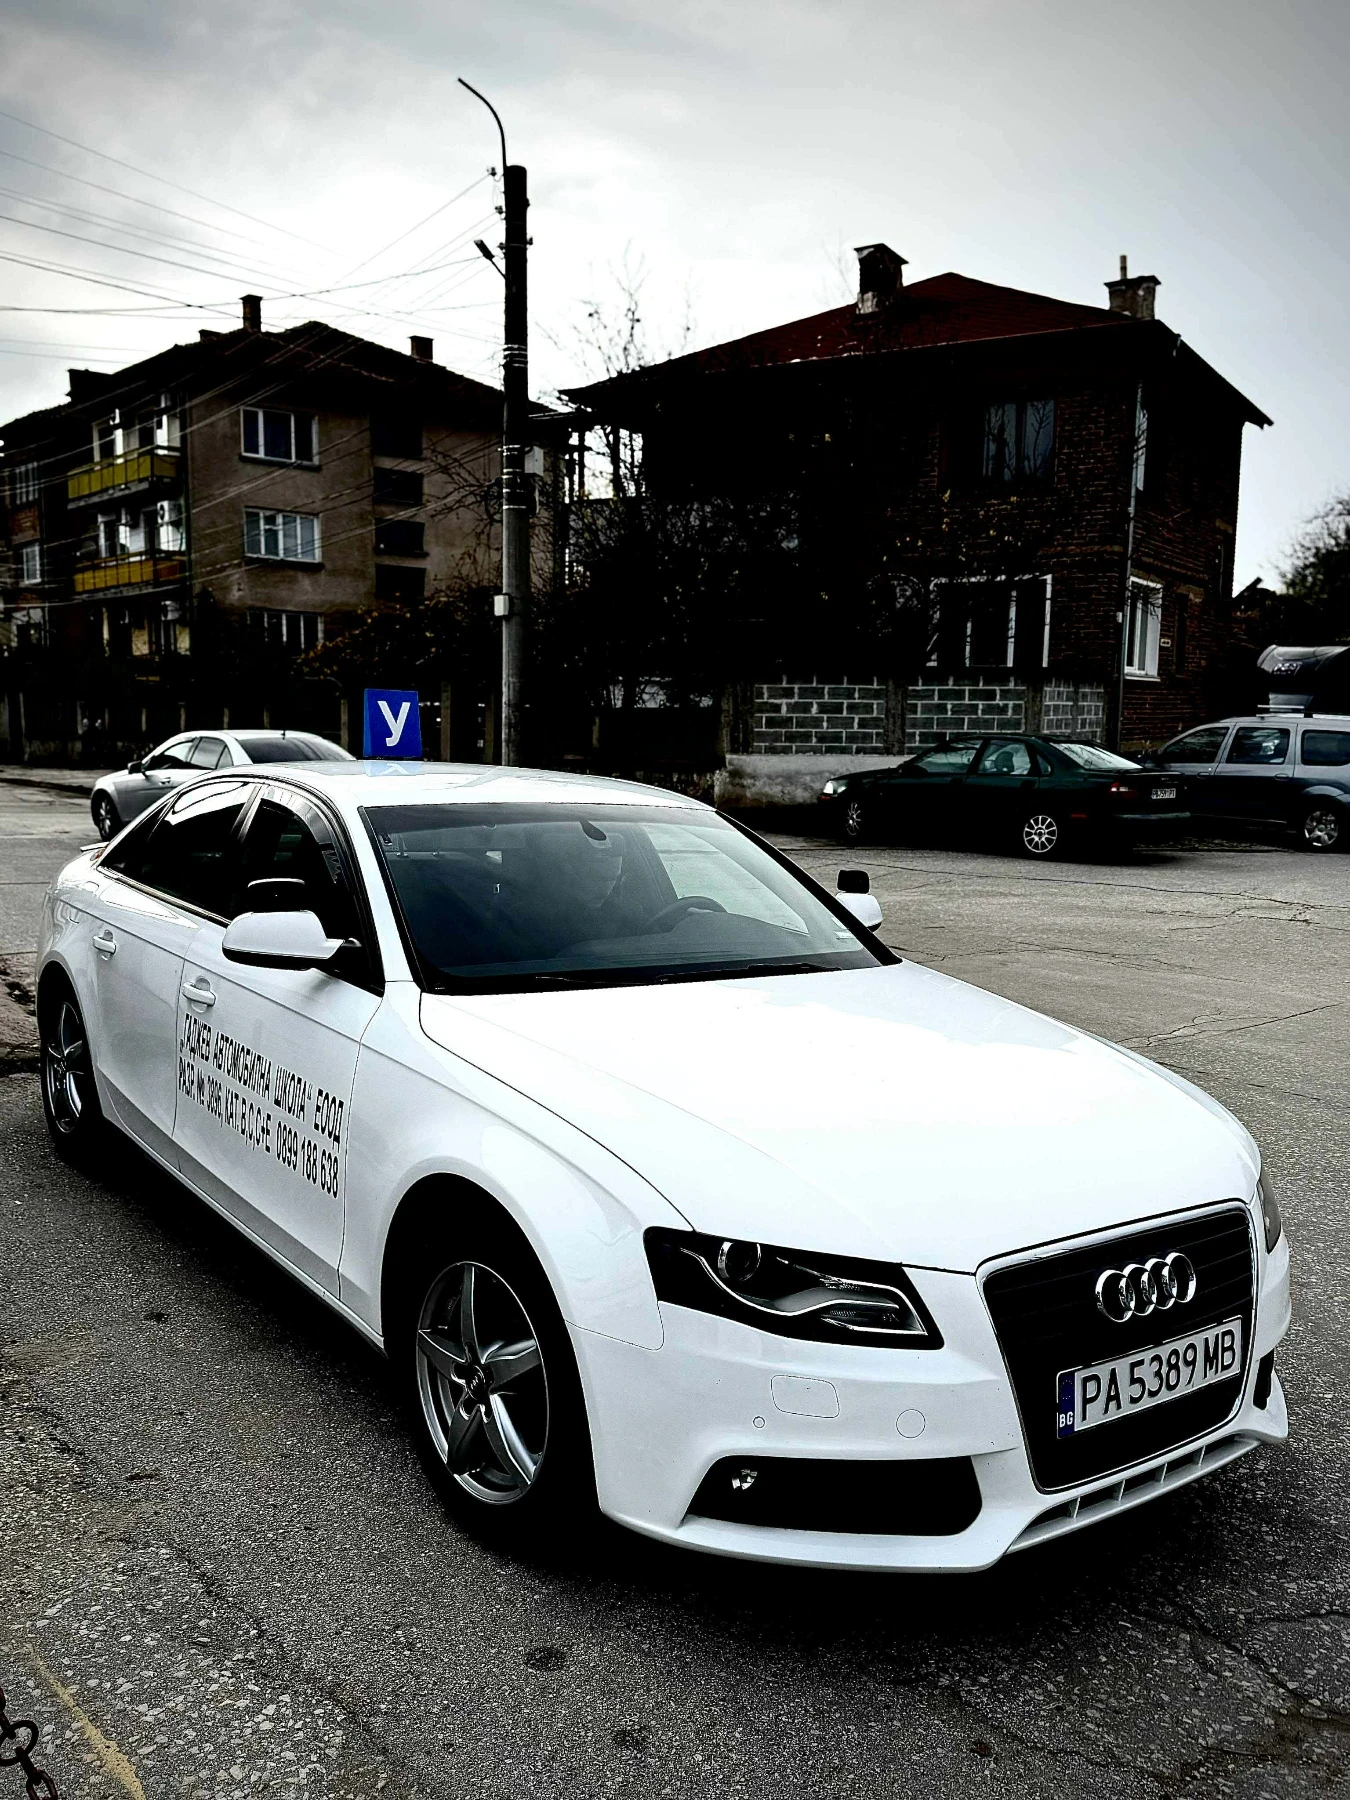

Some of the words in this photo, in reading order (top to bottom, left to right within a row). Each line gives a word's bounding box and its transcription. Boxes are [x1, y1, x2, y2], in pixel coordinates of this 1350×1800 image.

[213, 1031, 272, 1101] АВТОМОБИЛНА
[314, 1088, 344, 1153] ЕООД
[276, 1120, 298, 1171] 0899
[301, 1136, 318, 1185] 188
[320, 1148, 339, 1198] 638
[1059, 1411, 1074, 1428] BG
